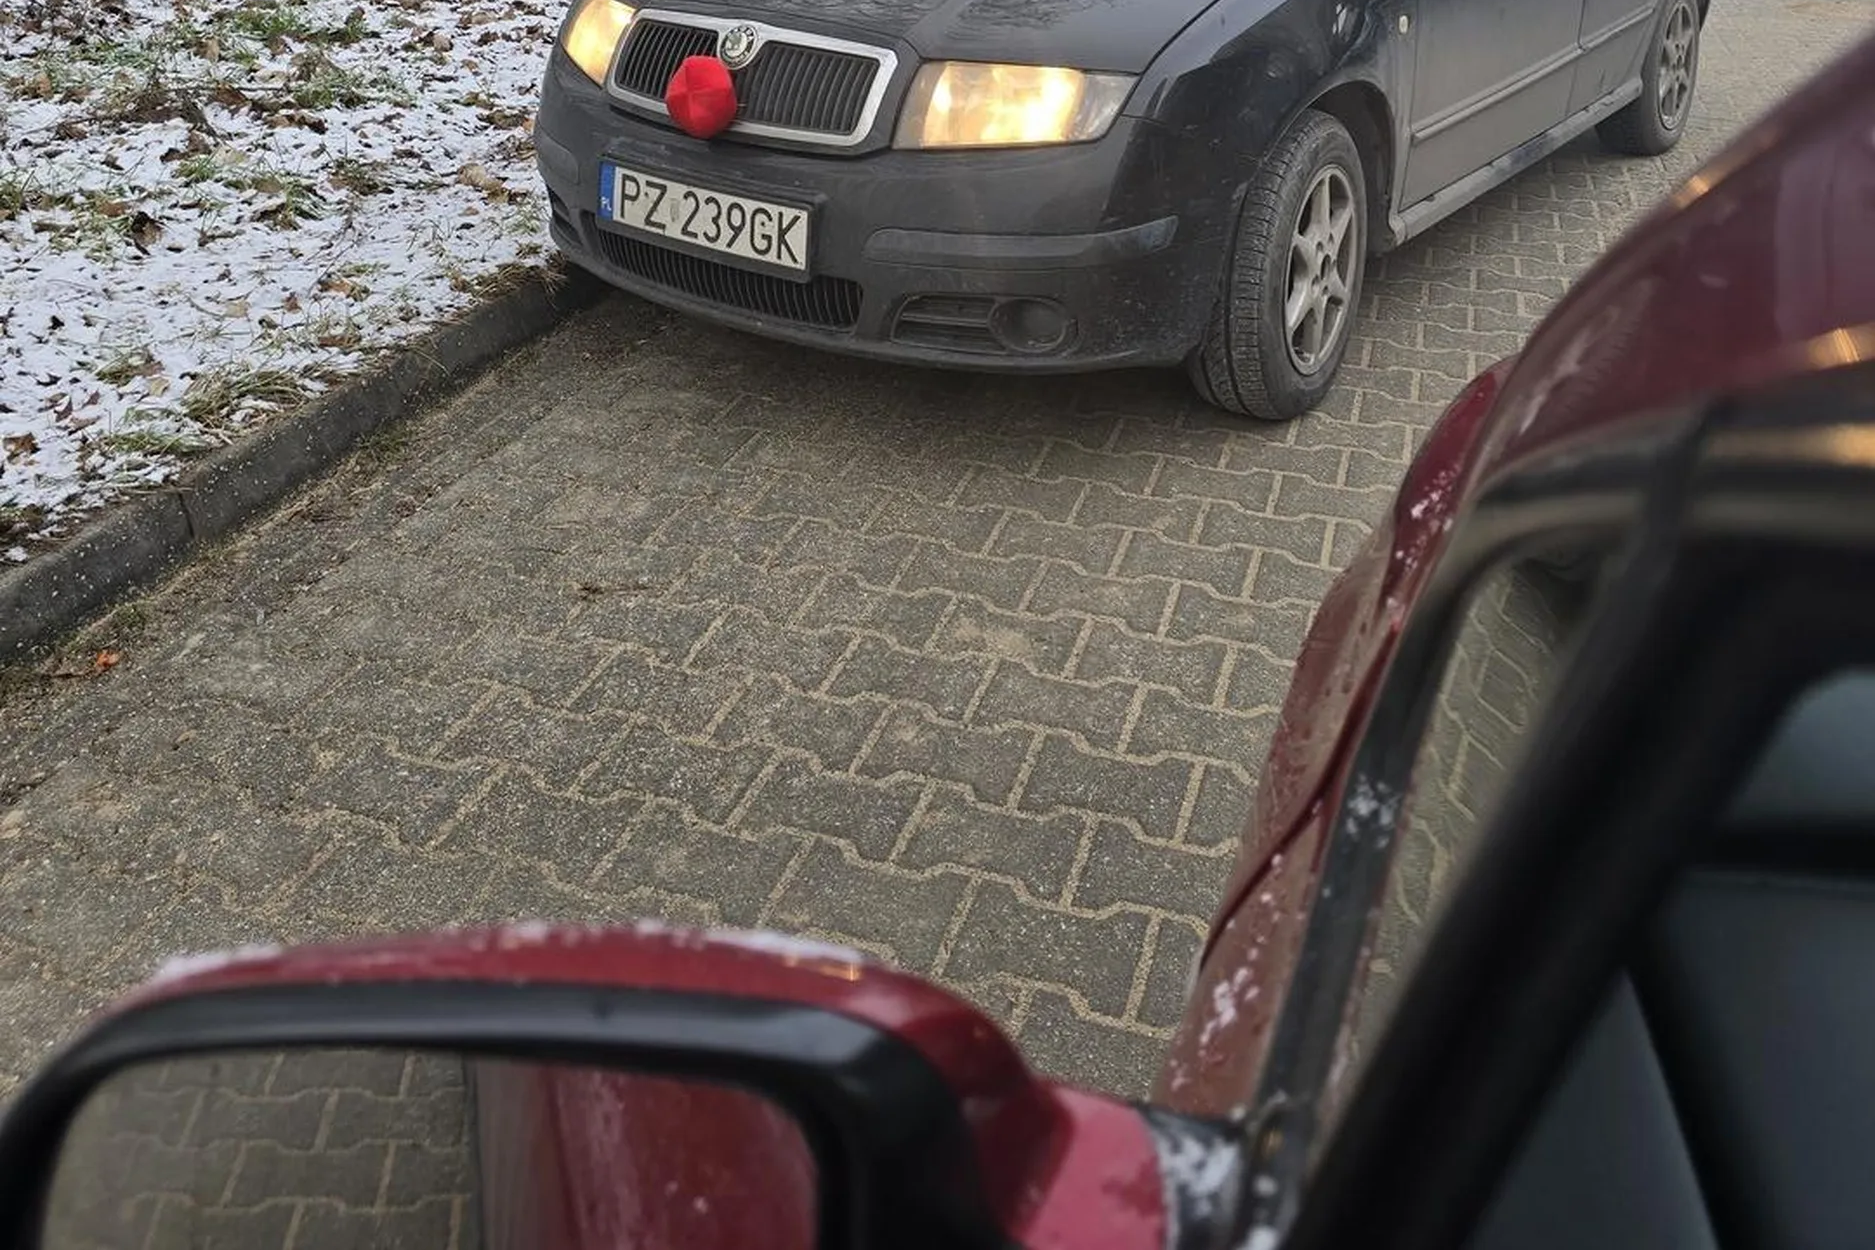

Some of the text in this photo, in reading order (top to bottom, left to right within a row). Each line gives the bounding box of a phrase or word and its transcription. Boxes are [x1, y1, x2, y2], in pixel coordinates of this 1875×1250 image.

[601, 196, 612, 211] PL
[620, 173, 801, 264] PZ 239GK
